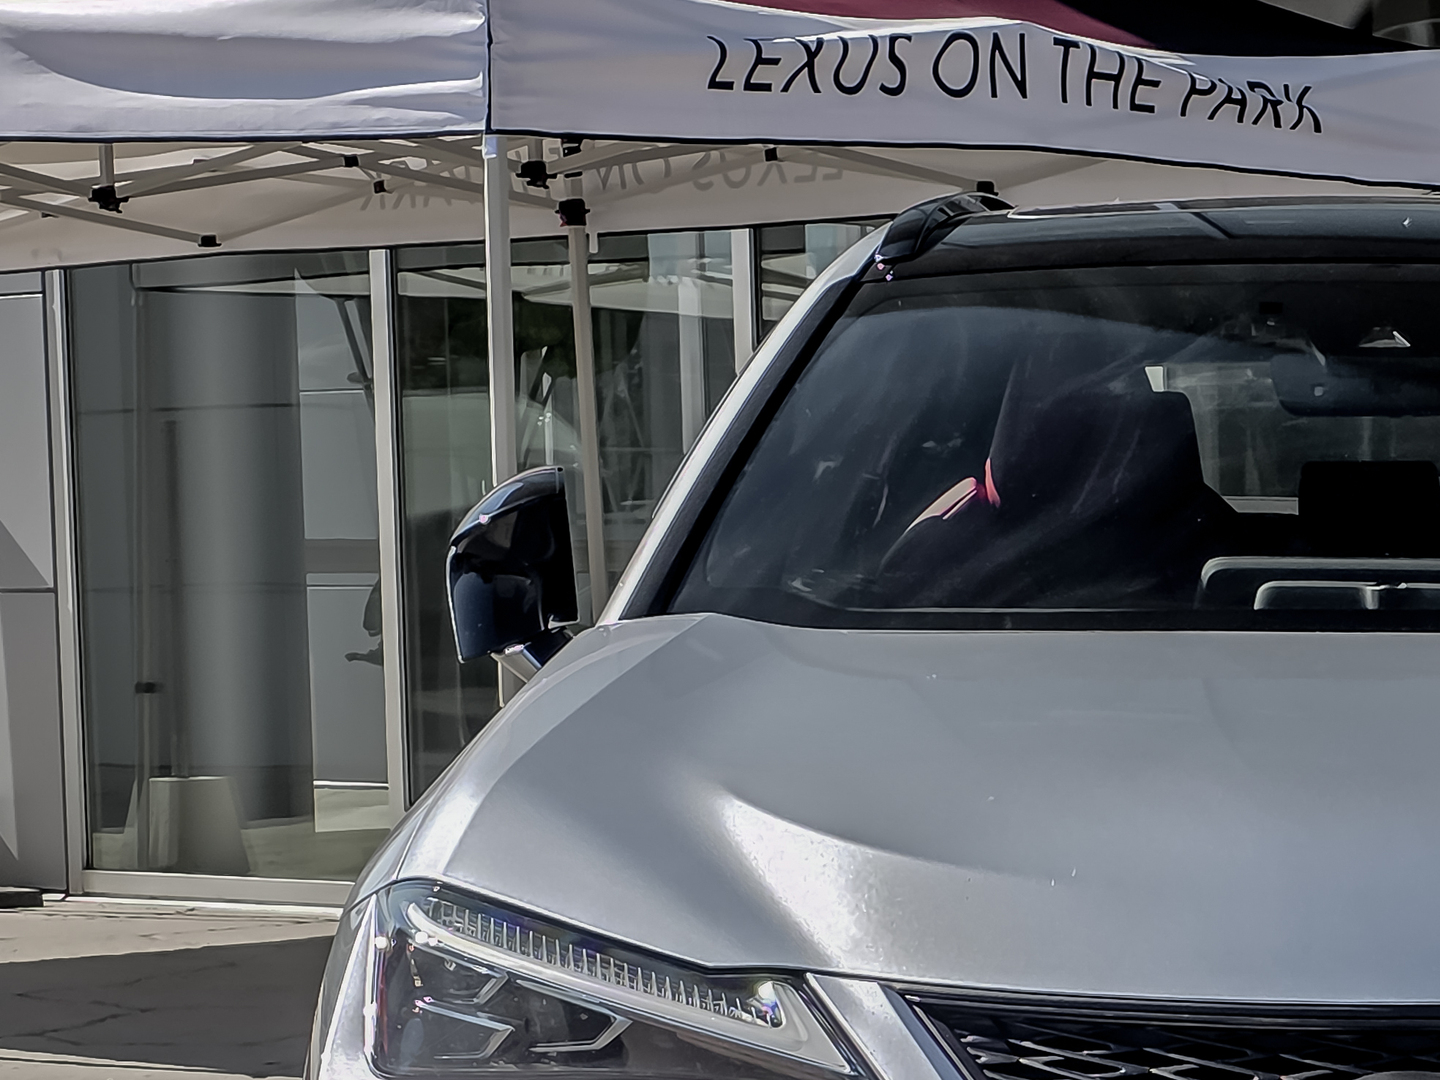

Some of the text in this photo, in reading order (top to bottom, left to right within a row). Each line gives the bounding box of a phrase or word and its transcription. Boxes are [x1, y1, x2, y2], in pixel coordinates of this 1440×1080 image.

[707, 30, 1322, 133] LEXUS ON THE PARK
